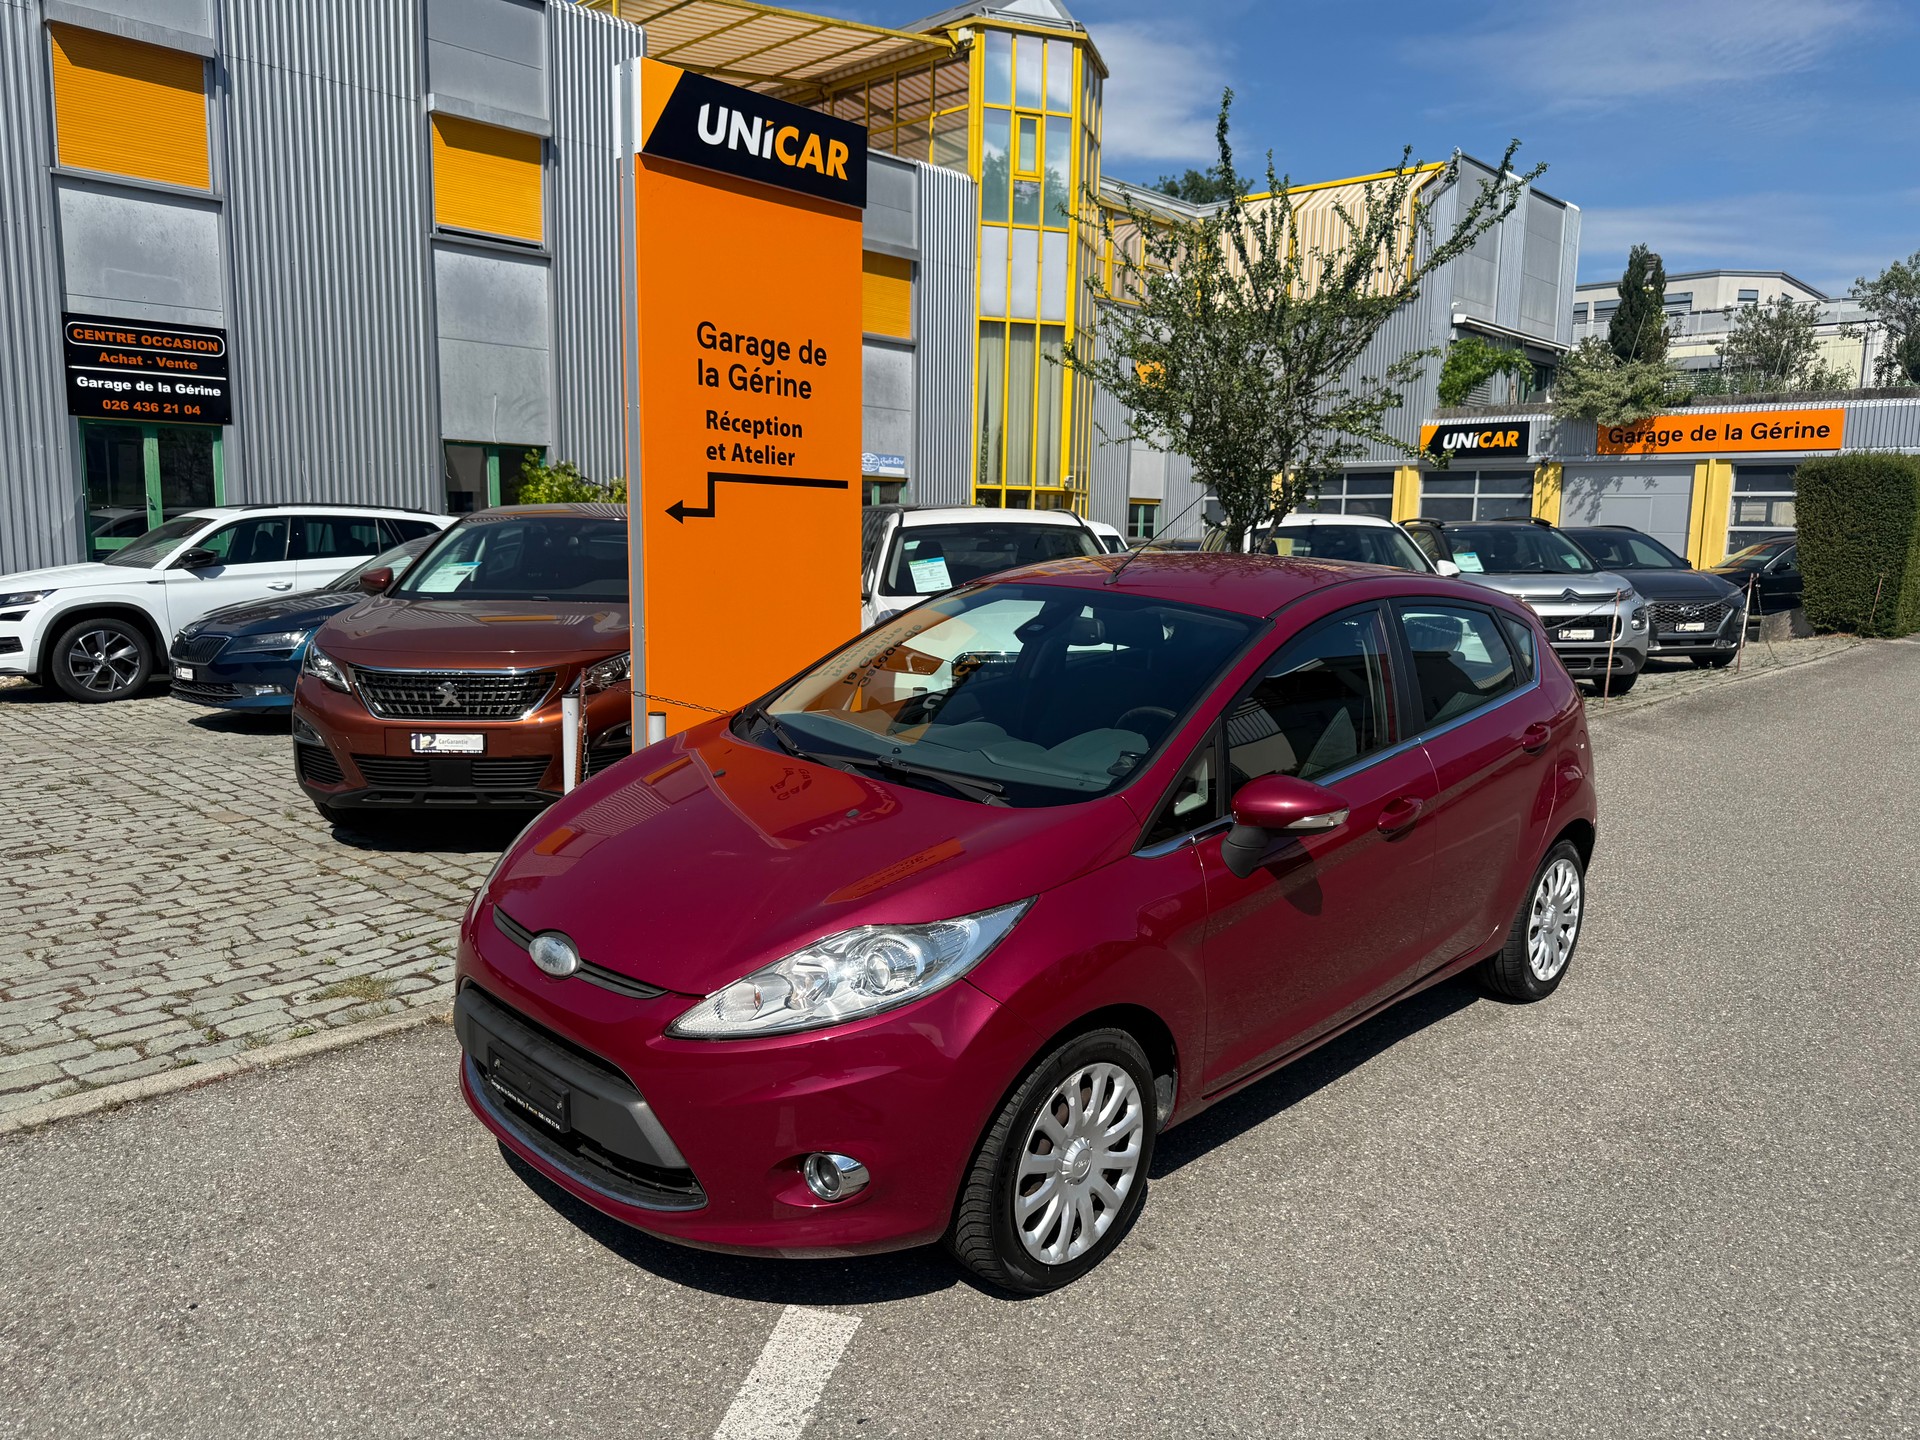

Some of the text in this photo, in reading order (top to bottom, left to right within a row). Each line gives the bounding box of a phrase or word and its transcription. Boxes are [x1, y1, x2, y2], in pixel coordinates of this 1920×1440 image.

[73, 328, 219, 352] CENTRE OCCASION
[696, 321, 827, 366] Garage de
[99, 352, 143, 366] Achat
[156, 356, 198, 370] Vente
[76, 376, 221, 396] Garage de la Gérine
[697, 358, 812, 399] la Gérine
[102, 400, 201, 415] 026 436 21 04
[706, 410, 803, 439] Réception
[1608, 421, 1830, 446] Garage de la Gérine
[706, 443, 796, 466] et Atelier
